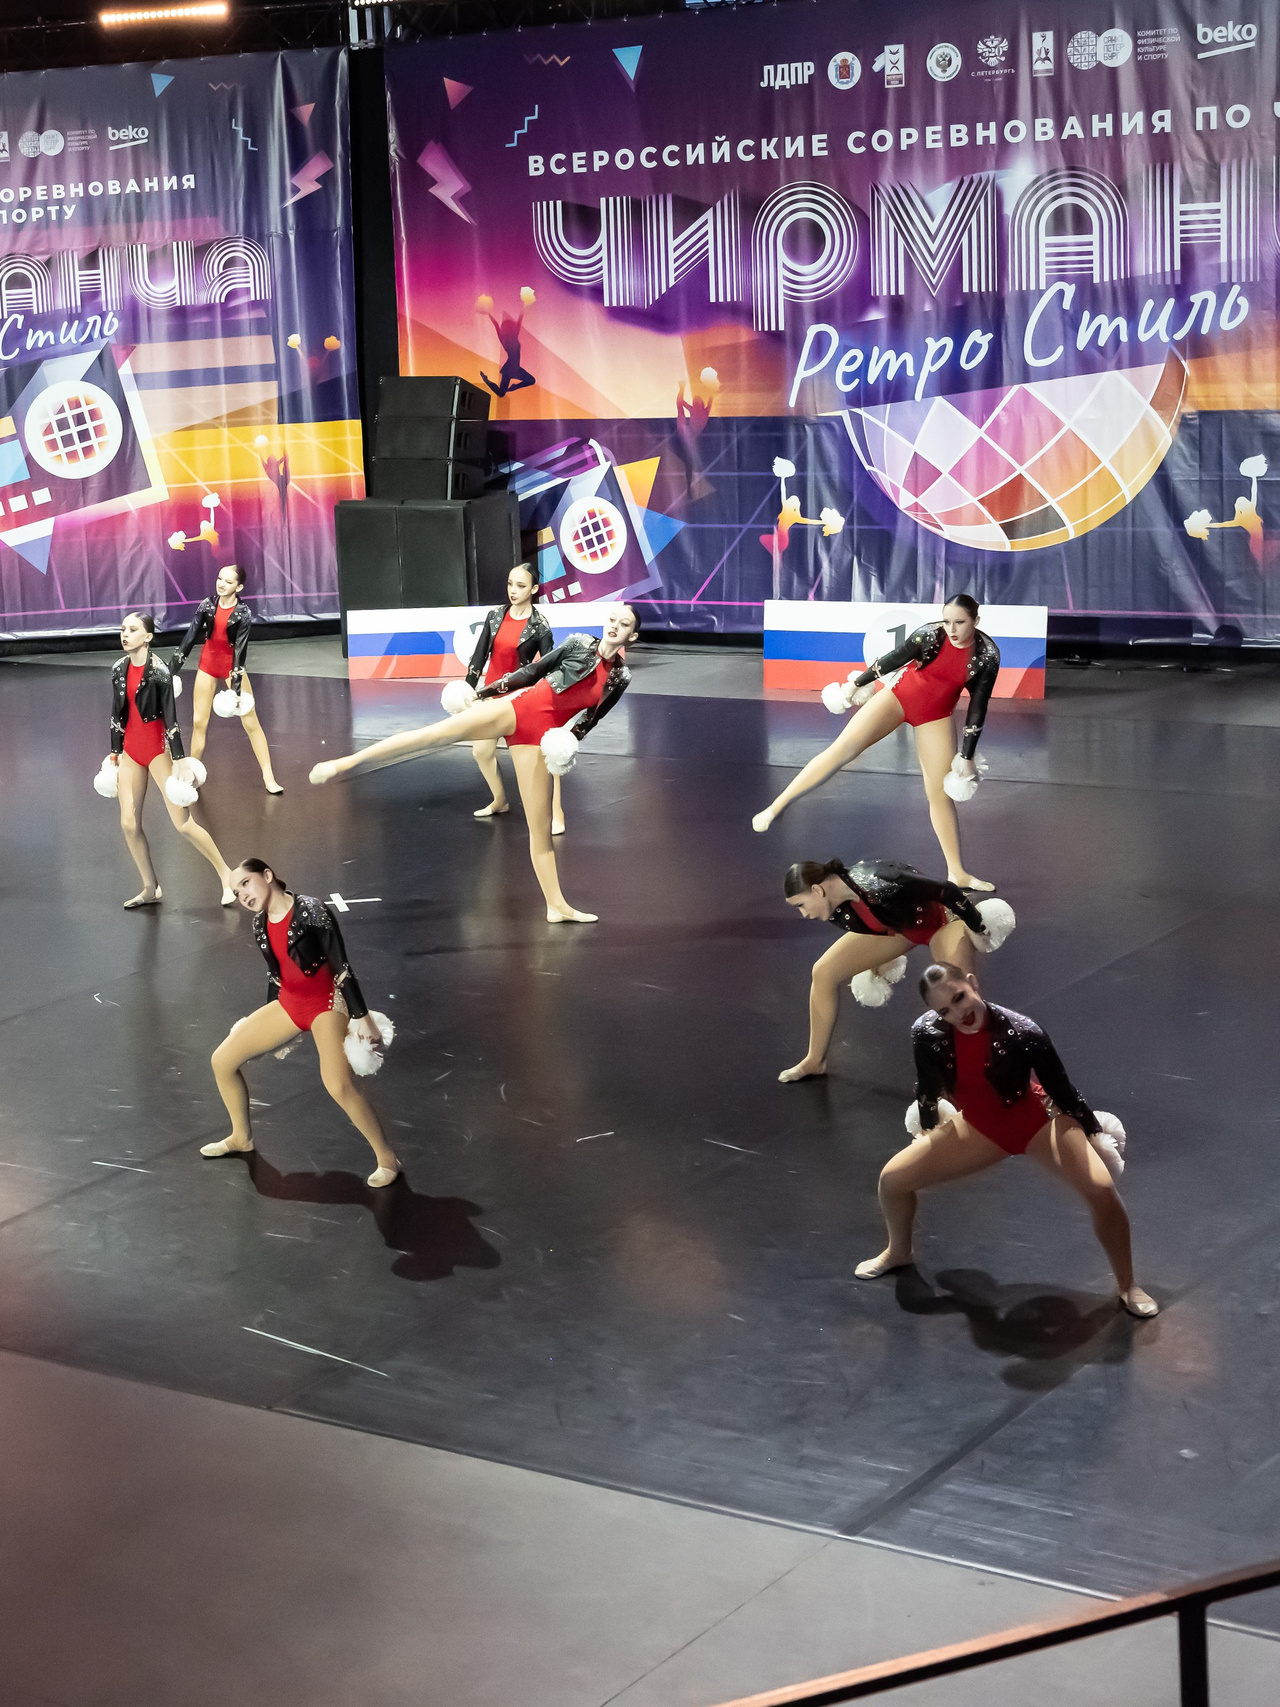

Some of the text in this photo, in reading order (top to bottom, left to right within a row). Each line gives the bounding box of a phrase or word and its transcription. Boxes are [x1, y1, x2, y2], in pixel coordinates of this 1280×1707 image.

[1137, 28, 1167, 37] КОМИТЕТ
[1196, 20, 1257, 44] beko
[1144, 52, 1169, 61] СПОРТУ
[760, 62, 815, 90] ЛДПР
[108, 125, 149, 142] beko
[528, 104, 1251, 176] ВСЕРОССИЙСКИЕ СОРЕВНОВАНИЯ ПО
[532, 156, 1280, 331] ЧИРМАН
[788, 282, 1249, 407] Ретро Стиль
